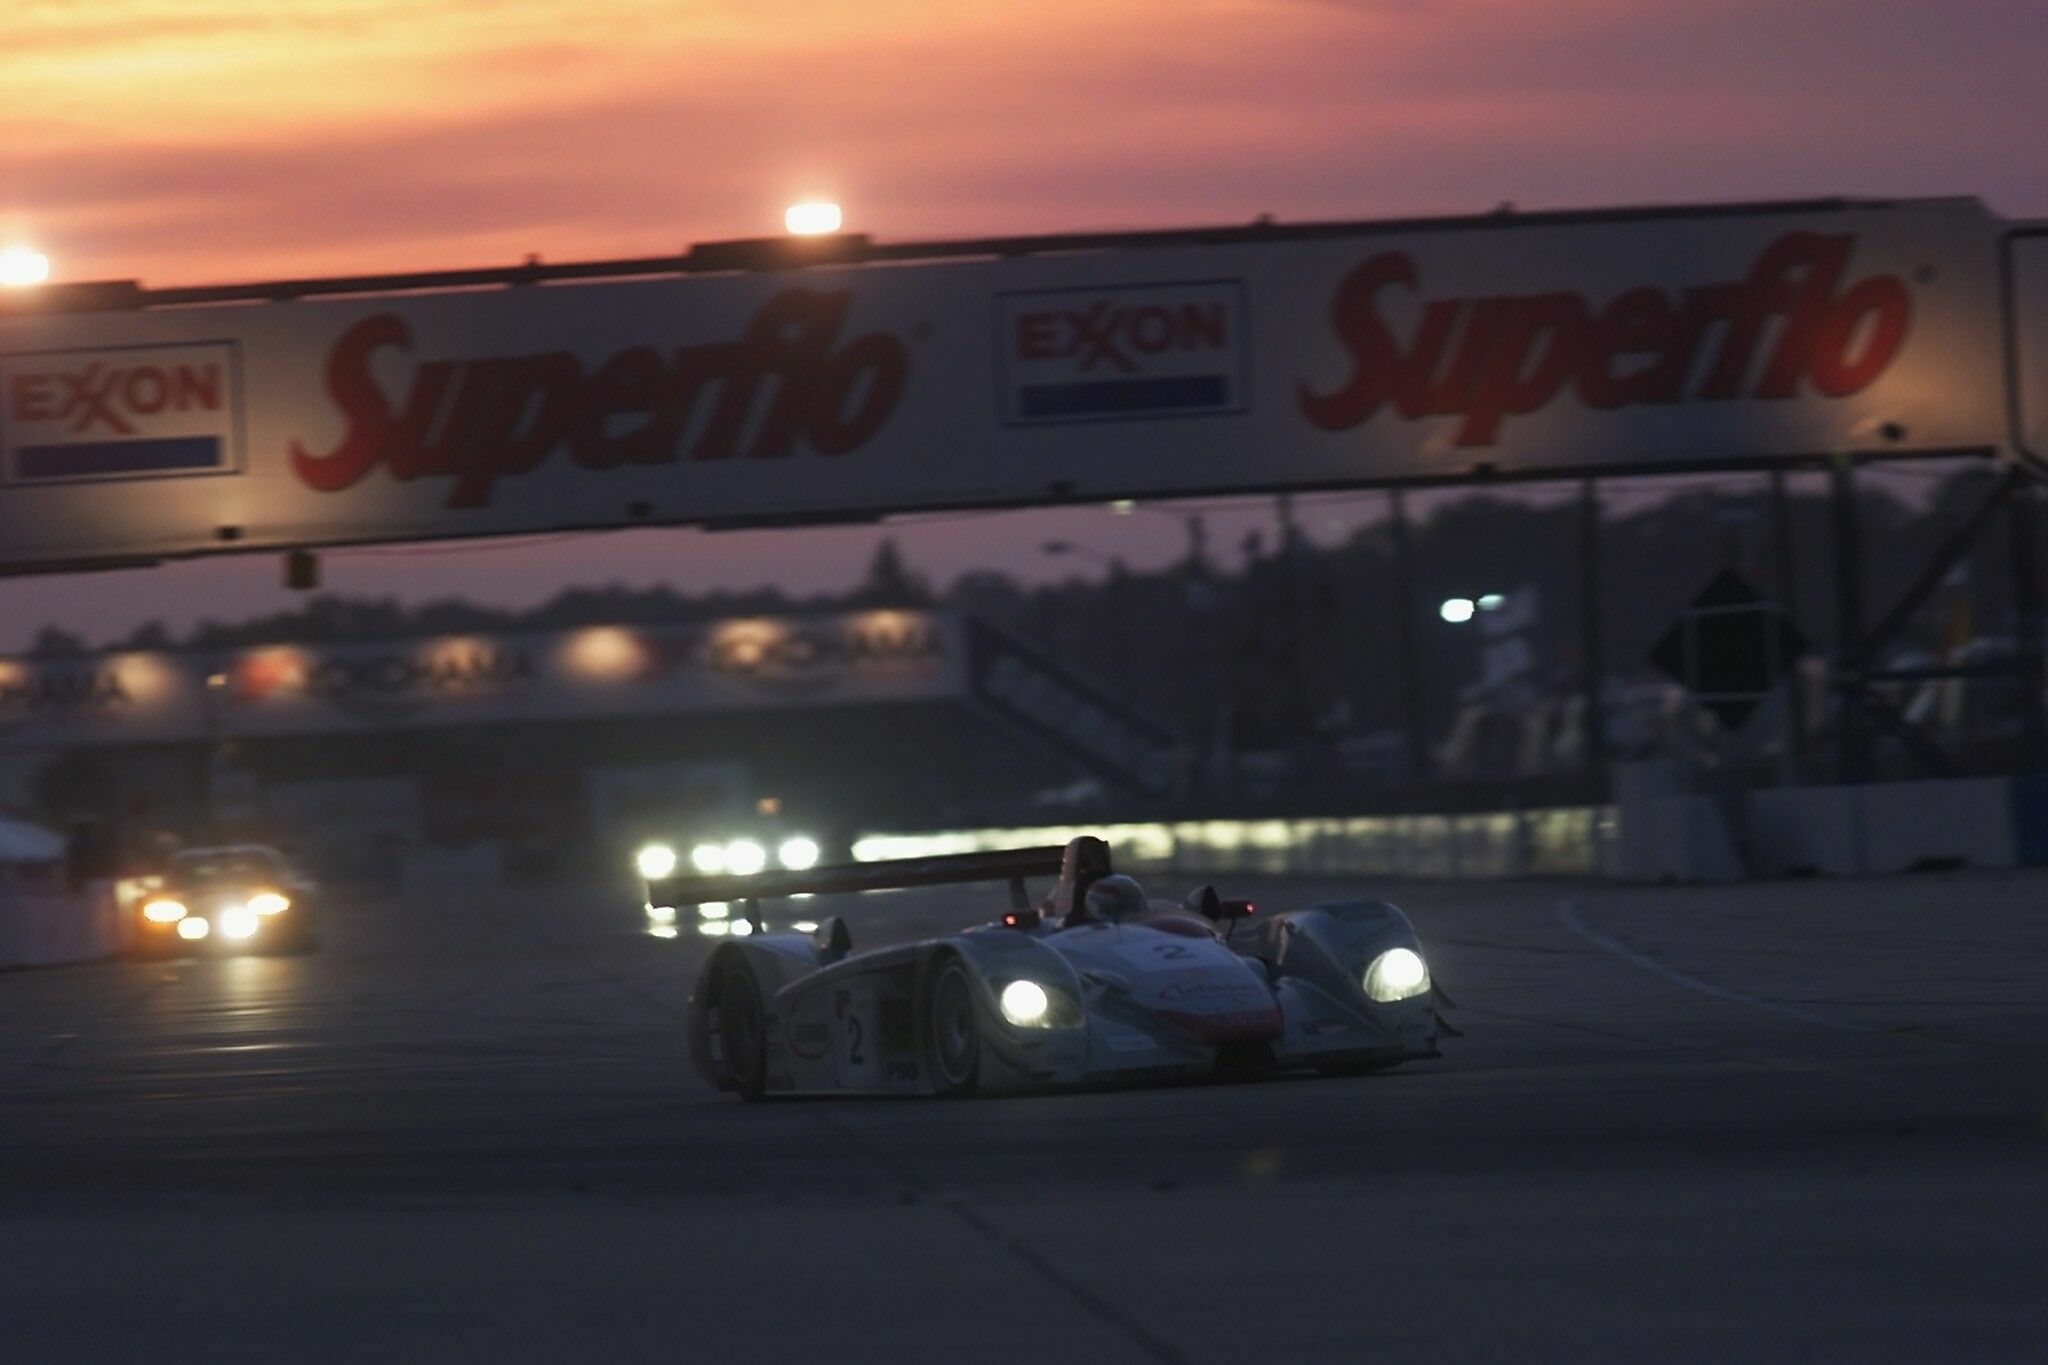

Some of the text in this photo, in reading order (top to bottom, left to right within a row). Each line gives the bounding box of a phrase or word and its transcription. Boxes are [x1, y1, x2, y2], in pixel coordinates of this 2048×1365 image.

[1017, 301, 1226, 374] EXXON
[1300, 231, 1912, 447] Superflo
[10, 361, 220, 434] EXXON
[289, 289, 910, 509] Superflo
[1152, 943, 1197, 960] 2
[847, 1015, 865, 1065] 2
